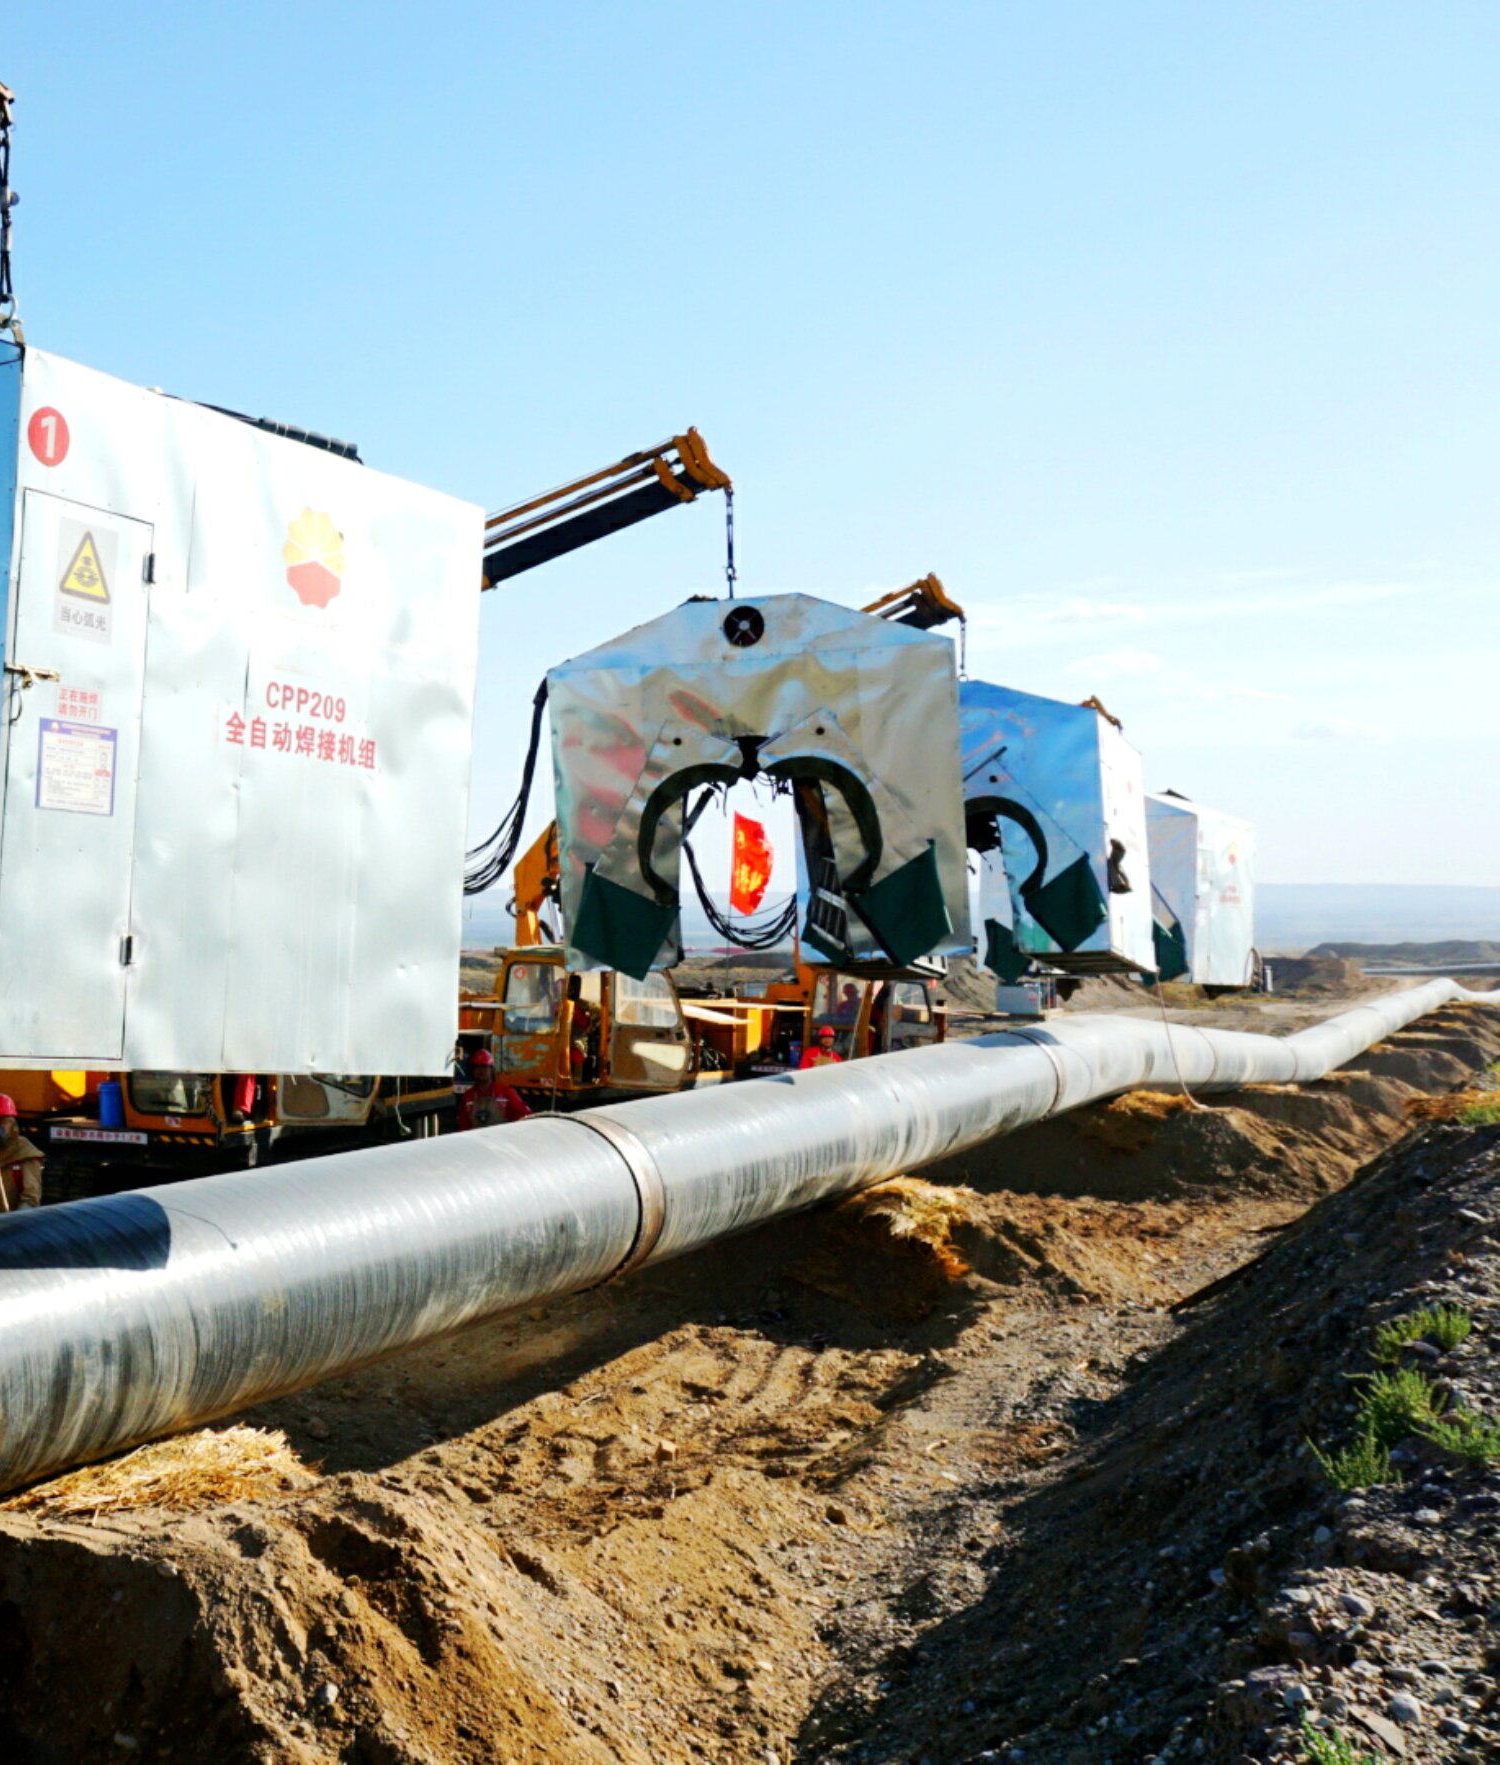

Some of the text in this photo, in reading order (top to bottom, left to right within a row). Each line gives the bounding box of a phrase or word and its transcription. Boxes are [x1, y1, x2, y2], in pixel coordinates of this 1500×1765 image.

[40, 415, 57, 459] 1
[266, 681, 346, 723] CPP209
[226, 711, 377, 770] 全自动焊接机组
